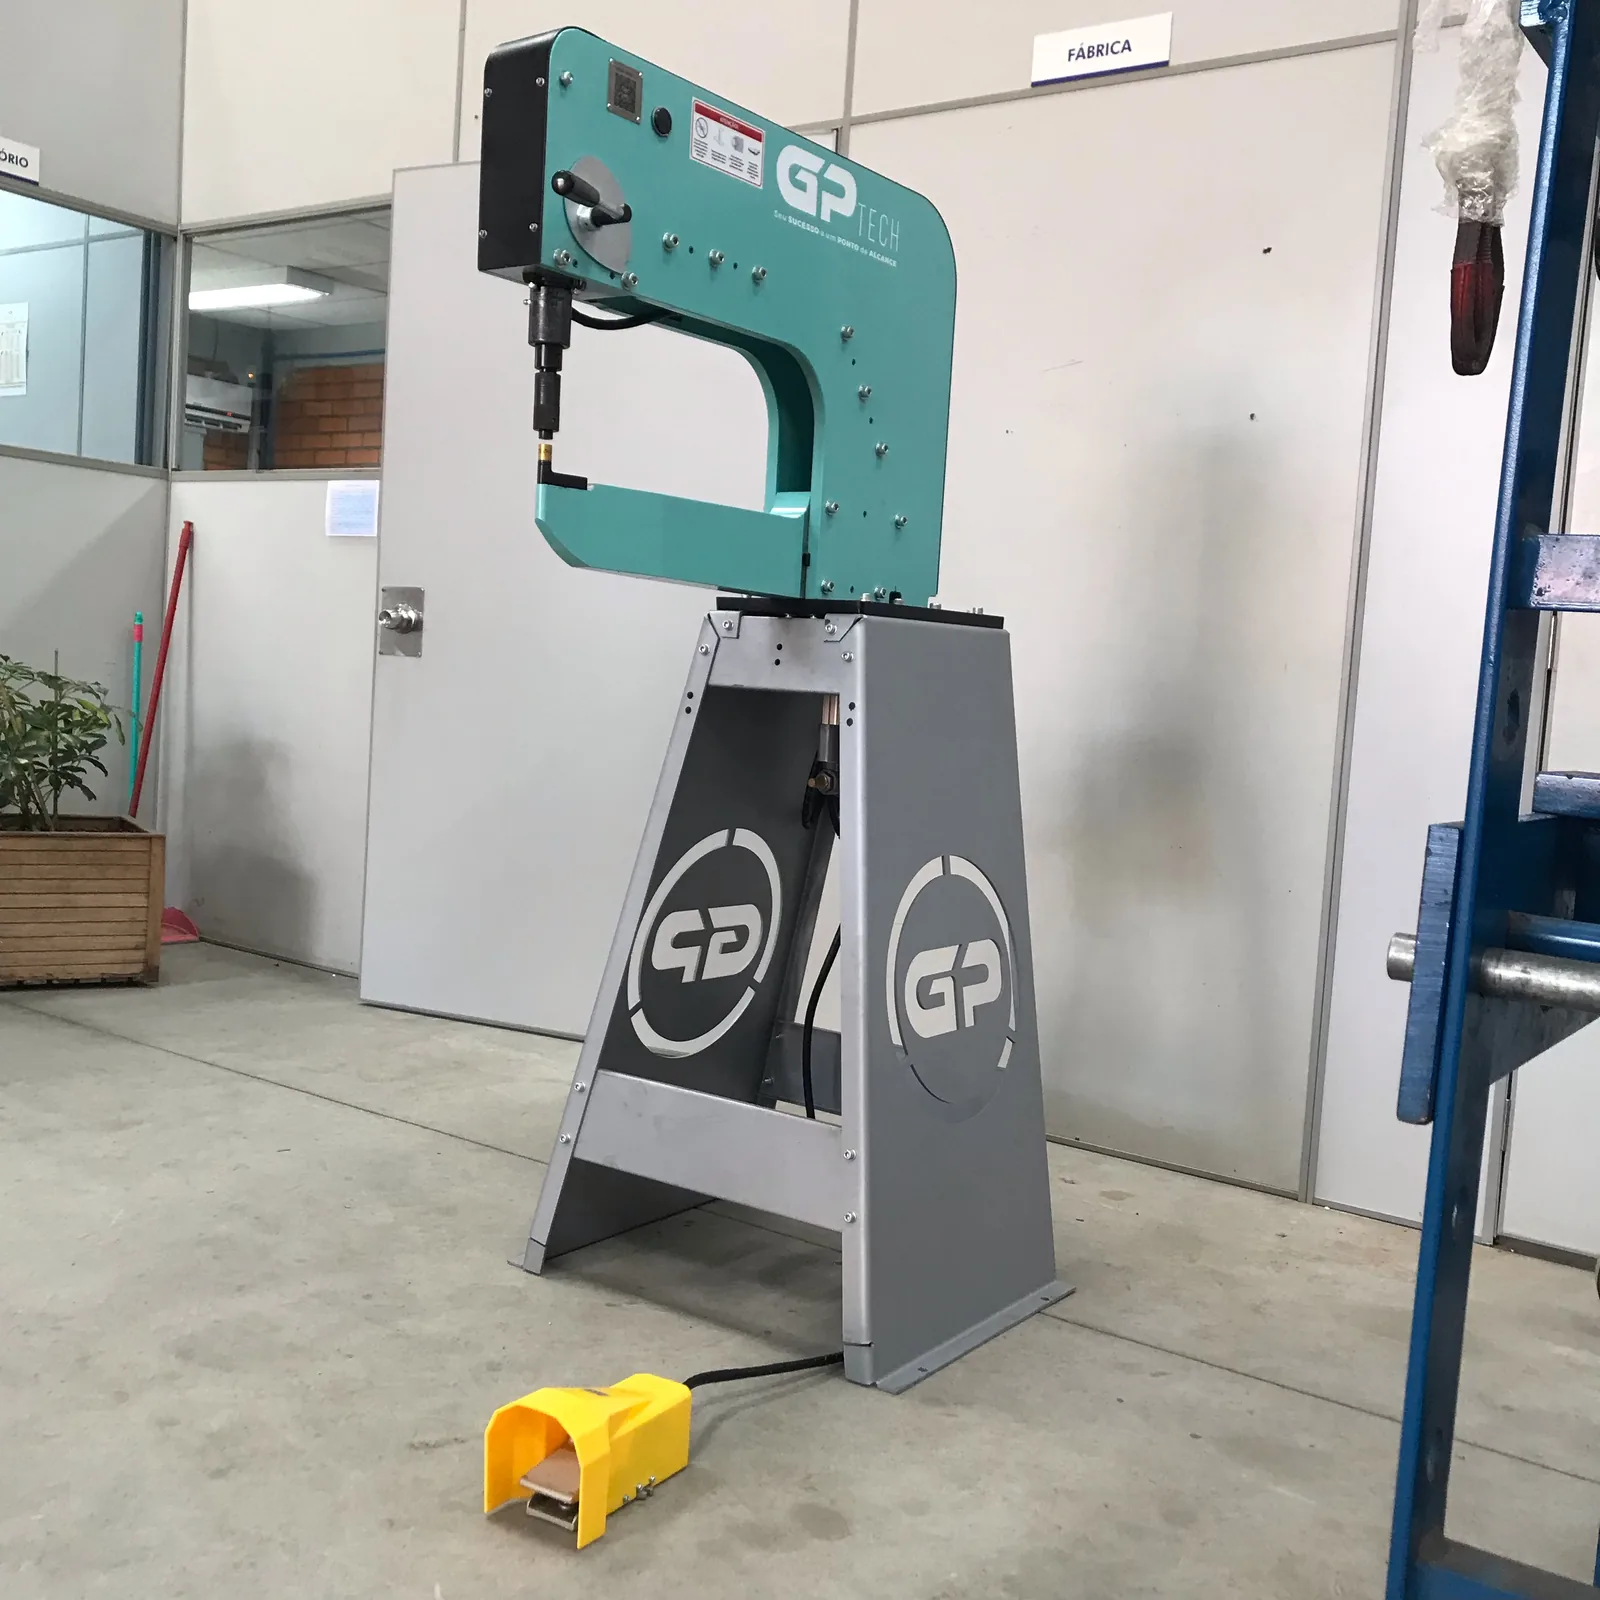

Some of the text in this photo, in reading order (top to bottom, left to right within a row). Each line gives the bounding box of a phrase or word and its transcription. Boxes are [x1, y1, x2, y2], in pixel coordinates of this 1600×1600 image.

[1067, 39, 1132, 62] FÁBRICA
[776, 144, 900, 252] GP TECH
[788, 215, 820, 235] SUCESSO
[837, 236, 860, 252] PONTO
[868, 250, 898, 268] ALCANCE
[904, 938, 1002, 1039] GP
